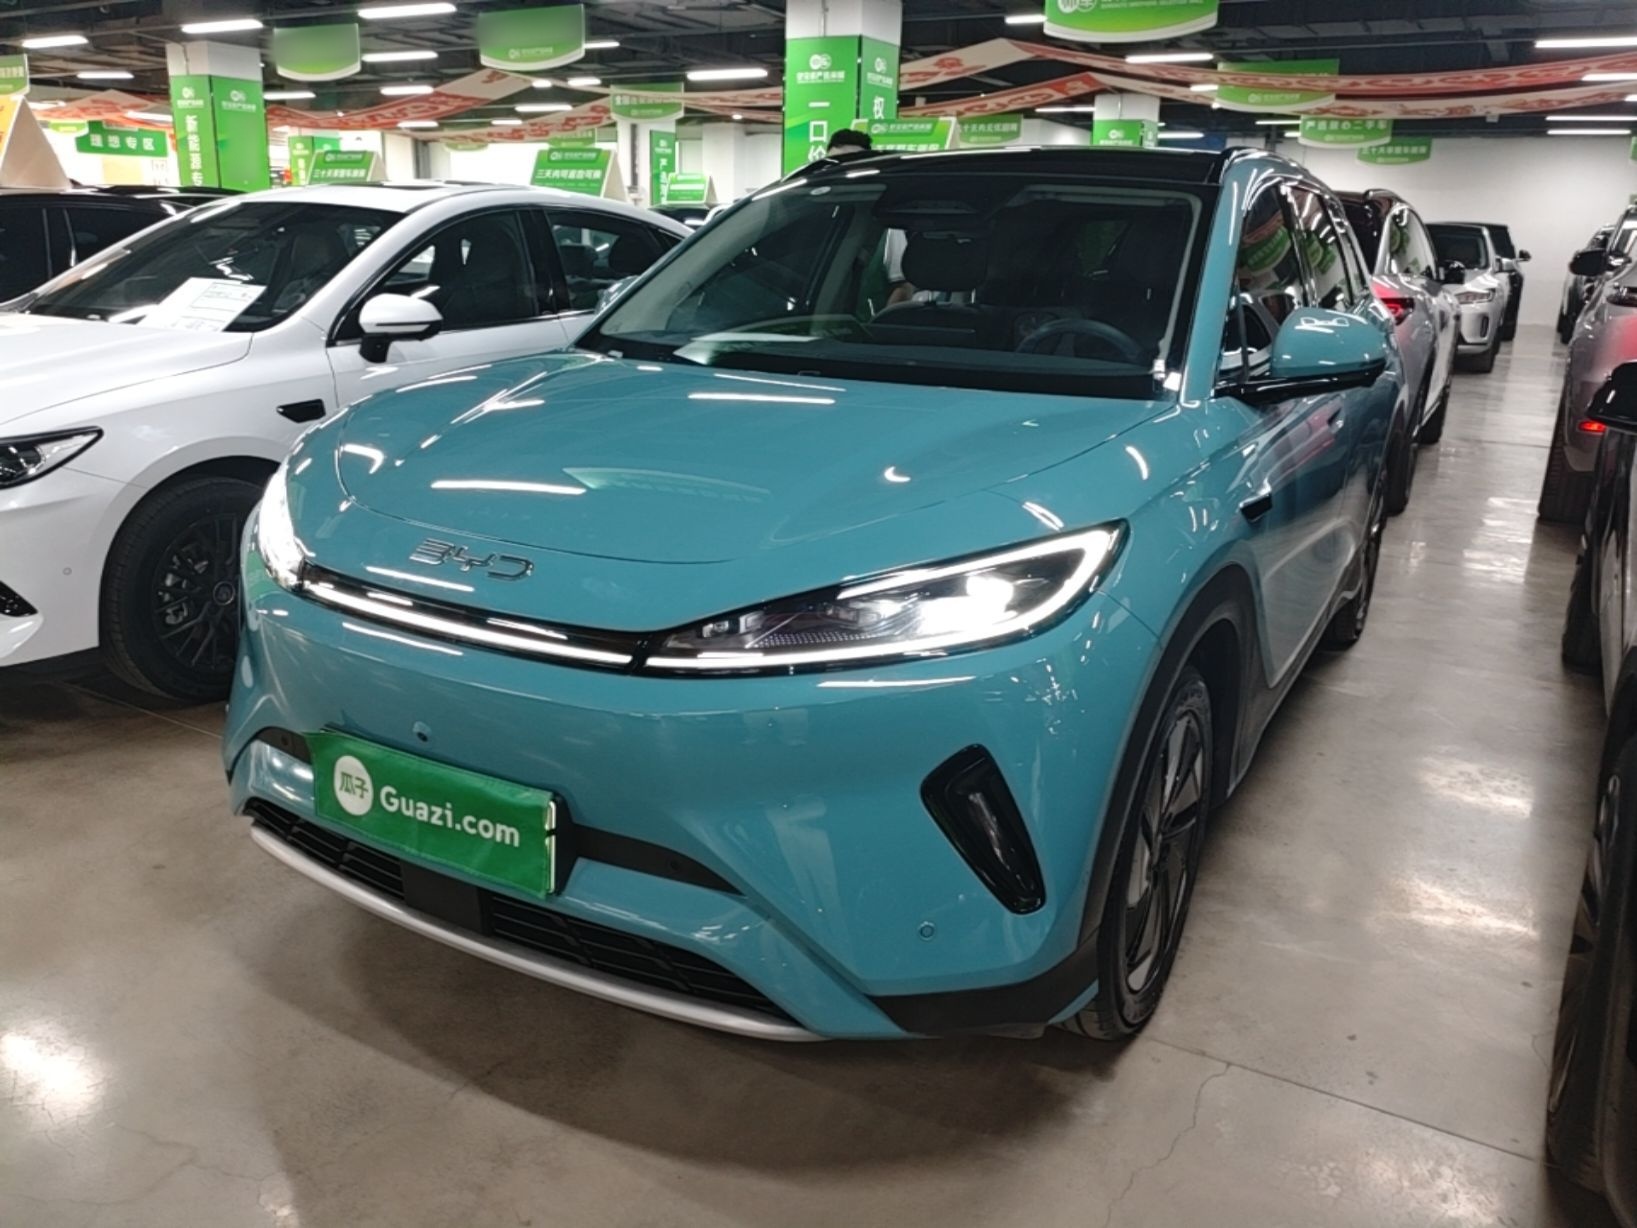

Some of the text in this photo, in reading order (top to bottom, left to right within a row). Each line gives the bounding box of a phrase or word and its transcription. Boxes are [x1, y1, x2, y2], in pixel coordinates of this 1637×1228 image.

[409, 537, 535, 581] BYD
[339, 771, 520, 847] 瓜子 Guazi.com
